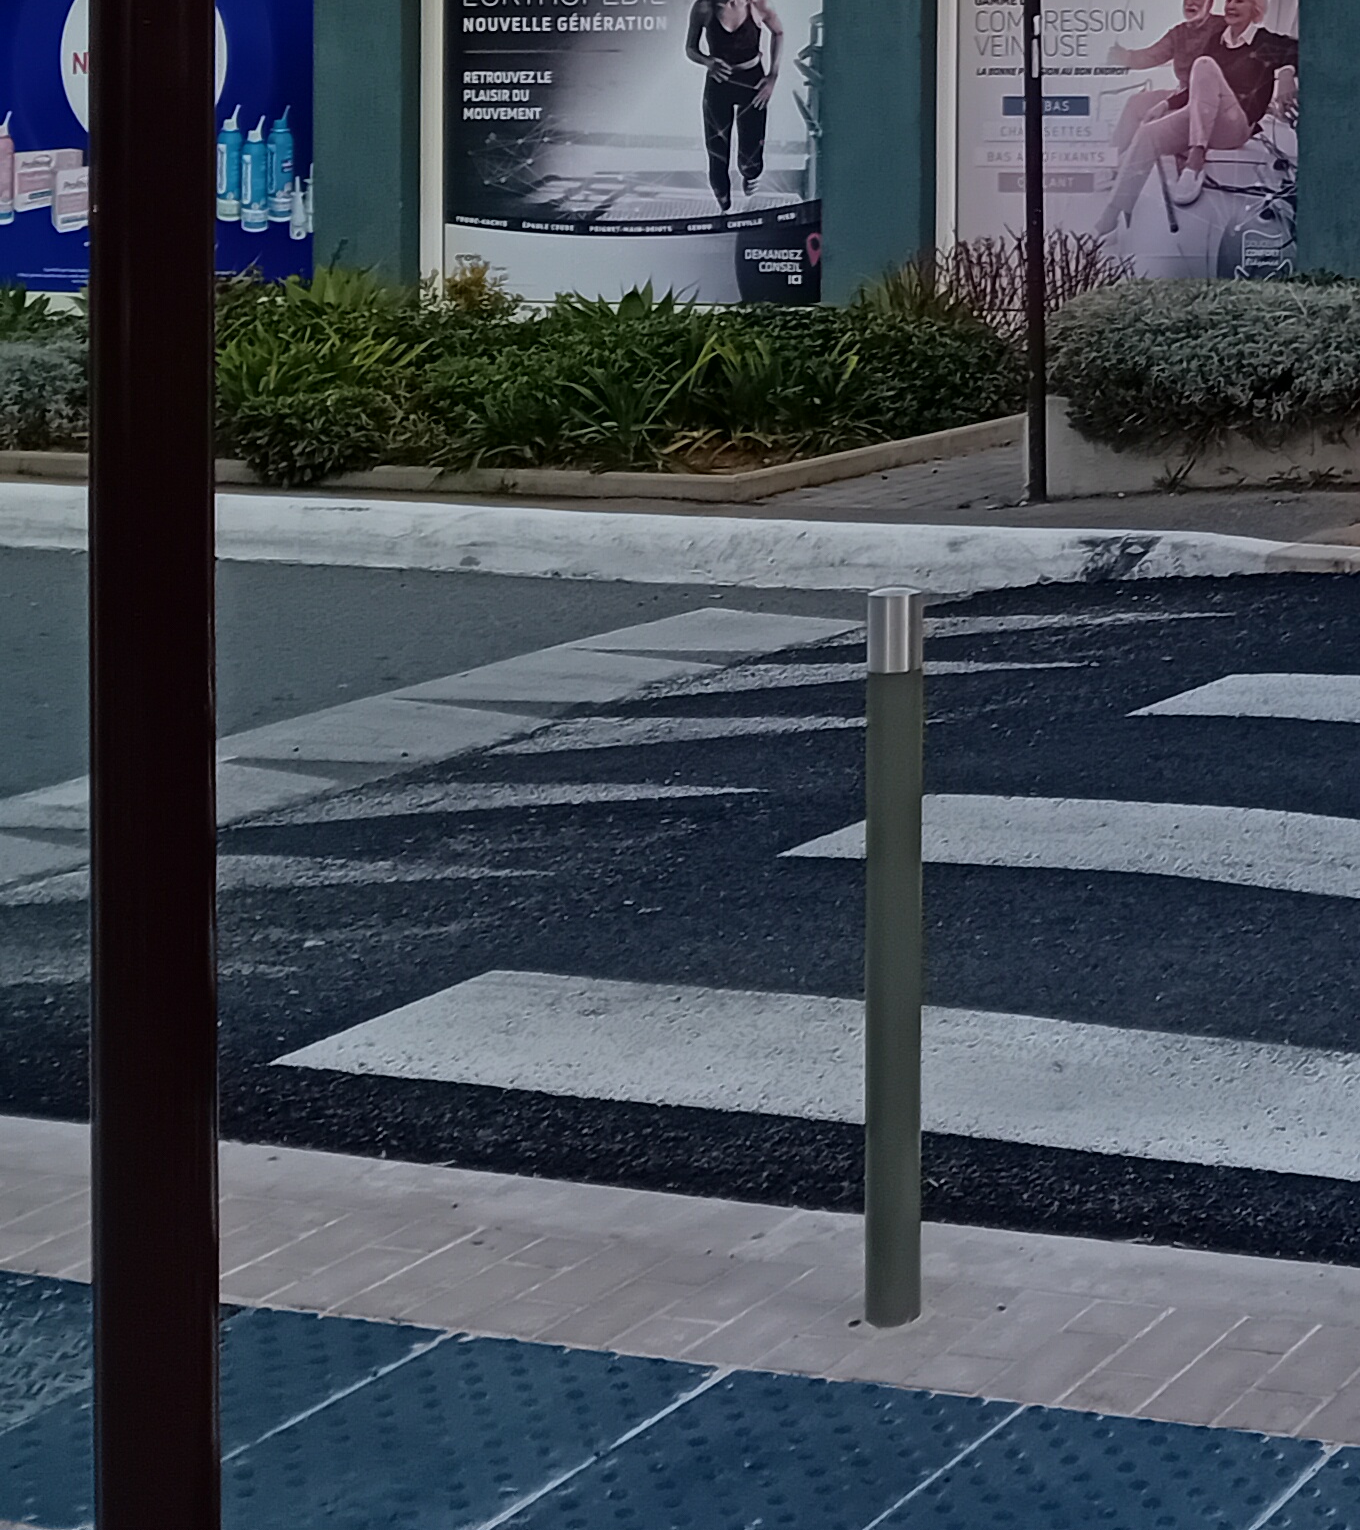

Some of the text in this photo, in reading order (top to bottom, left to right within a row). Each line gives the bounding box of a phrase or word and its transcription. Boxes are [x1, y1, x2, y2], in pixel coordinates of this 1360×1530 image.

[463, 13, 667, 33] NOUVELLE GÉNÉRATION
[974, 9, 1145, 34] COMRESSION
[974, 34, 1089, 58] VEINUSE
[463, 72, 552, 84] RETROUVEZ LE
[463, 90, 530, 102] PLAISIR DU
[463, 107, 542, 120] MOUVEMENT
[744, 249, 803, 260] DEMANDEZ
